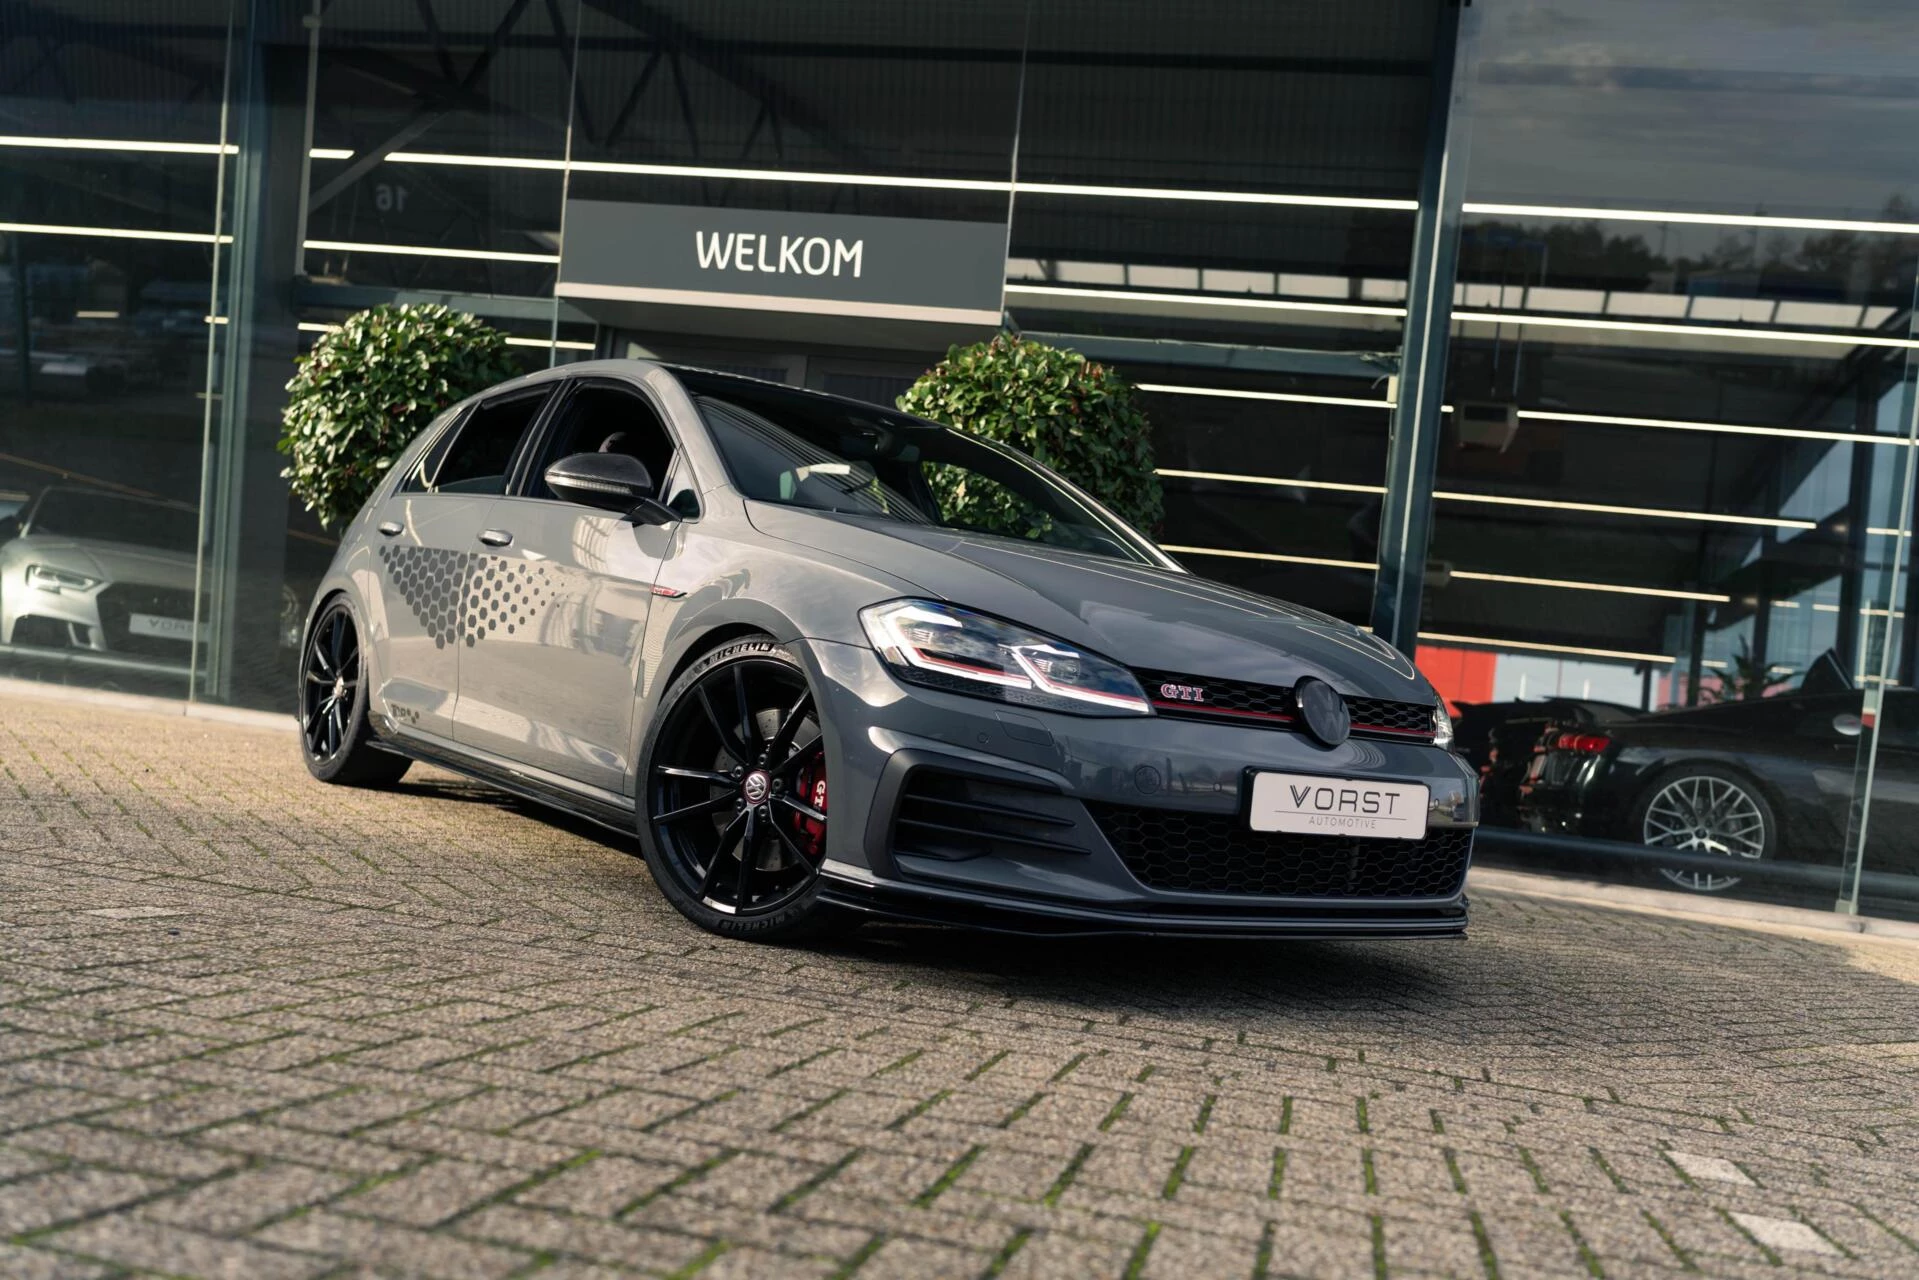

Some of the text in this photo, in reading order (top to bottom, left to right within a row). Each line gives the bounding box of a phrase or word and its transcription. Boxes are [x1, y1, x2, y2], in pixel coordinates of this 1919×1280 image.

[695, 230, 864, 278] WELKOM
[709, 642, 773, 666] MICHELIN
[1160, 683, 1205, 702] GTI
[1289, 784, 1401, 815] VORST
[1308, 816, 1377, 829] AUTOMOTIVE
[721, 914, 785, 931] MICHELIN
